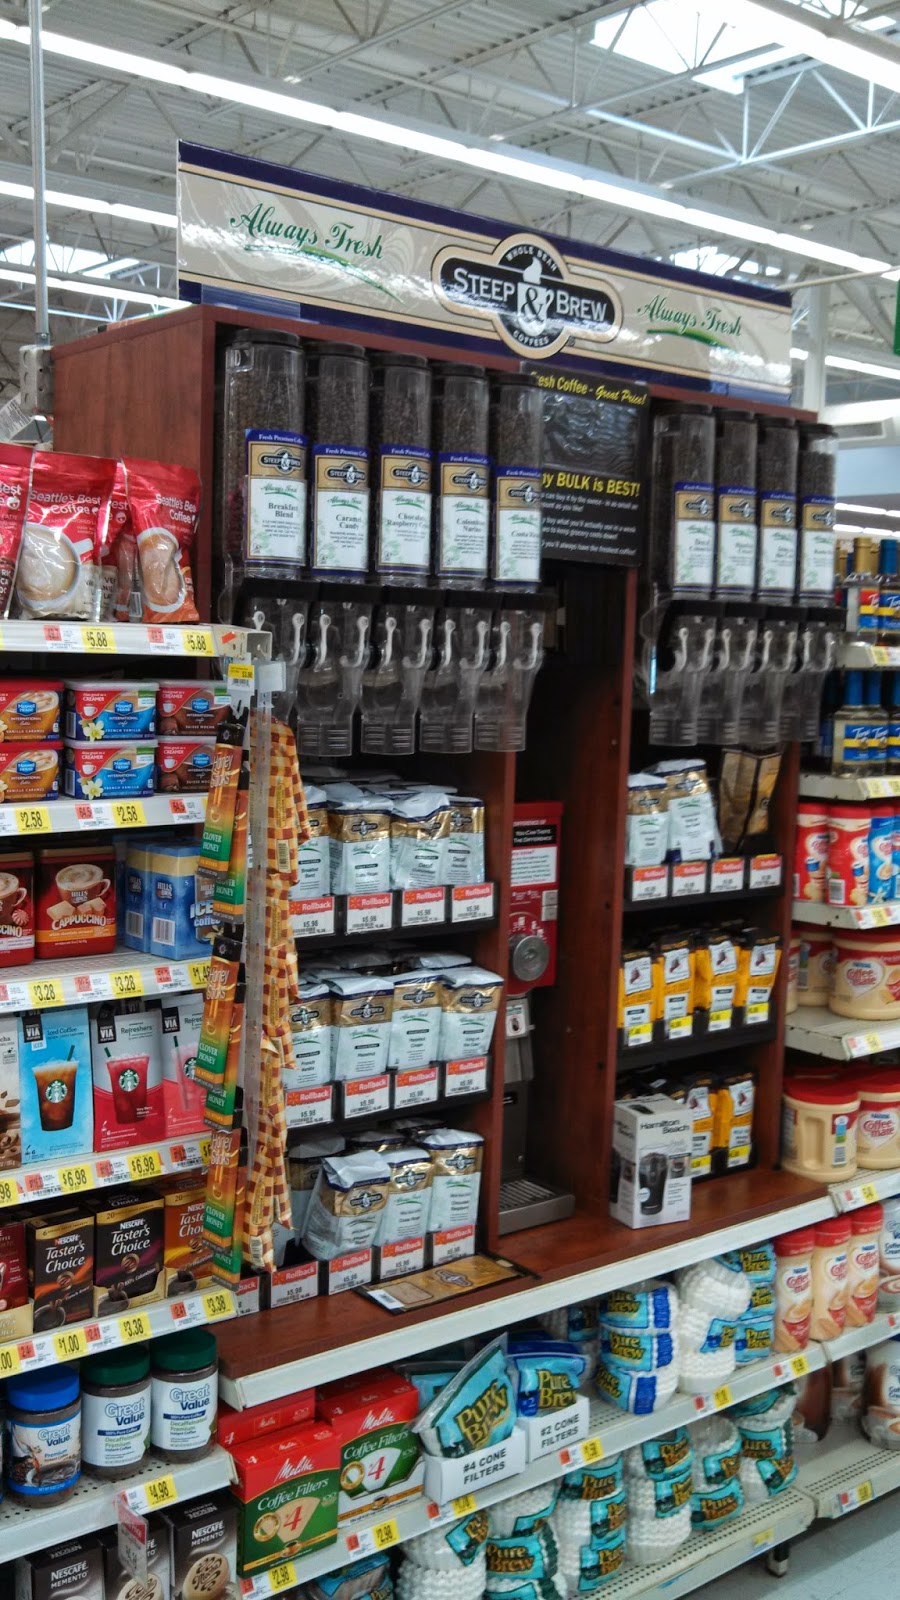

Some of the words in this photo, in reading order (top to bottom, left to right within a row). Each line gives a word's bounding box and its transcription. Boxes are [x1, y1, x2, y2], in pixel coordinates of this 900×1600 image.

[229, 203, 318, 247] Always
[324, 222, 384, 260] Fresh
[506, 245, 535, 262] WHOLE
[535, 247, 558, 272] BEAN
[453, 268, 516, 303] STEEP
[520, 287, 544, 316] &
[556, 293, 607, 322] BREW
[637, 295, 697, 334] Always
[700, 306, 742, 337] Fresh
[513, 330, 551, 348] COFFEES
[557, 377, 588, 395] Coffee
[596, 385, 620, 401] Great
[557, 472, 591, 491] BULK
[593, 478, 603, 493] is
[606, 480, 640, 498] BEST!
[29, 490, 76, 504] Seattle's
[77, 494, 102, 505] Best
[155, 494, 184, 510] Seattle's
[50, 503, 91, 514] Coffee
[169, 509, 192, 523] Coffee
[275, 510, 294, 519] Blend
[86, 632, 108, 648] $5.88
[187, 634, 207, 651] $5.88
[212, 754, 233, 774] Honey
[210, 771, 231, 788] Sticks
[20, 810, 43, 828] $2.58
[117, 806, 138, 822] $2.58
[203, 831, 222, 843] CLOVER
[203, 841, 219, 853] HONEY
[157, 881, 172, 890] HILLS
[216, 886, 234, 897] HONEY
[52, 914, 107, 930] CAPPUCCINO
[114, 974, 136, 991] $3.28
[209, 969, 230, 987] Honey
[34, 983, 56, 1001] $3.28
[120, 1025, 153, 1036] Refreshers
[164, 1019, 178, 1028] VIA
[26, 1028, 40, 1037] VIA
[100, 1029, 114, 1038] VIA
[199, 1042, 218, 1056] CLOVER
[198, 1053, 216, 1065] HONEY
[208, 1094, 225, 1107] HONEY
[640, 1119, 680, 1131] Hamilton
[662, 1125, 690, 1135] Beach
[863, 1119, 893, 1133] Coffee
[211, 1135, 232, 1152] Honey
[131, 1155, 155, 1173] $6.98
[62, 1169, 87, 1188] $6.98
[206, 1206, 225, 1220] CLOVER
[206, 1217, 224, 1230] HONEY
[111, 1224, 150, 1244] Taster's
[45, 1241, 85, 1260] Taster's
[111, 1239, 151, 1256] Choice
[45, 1256, 85, 1273] Choice
[207, 1294, 226, 1311] $3.38
[124, 1319, 144, 1337] $3.38
[59, 1336, 80, 1353] $1.00
[538, 1369, 572, 1389] Pure
[170, 1384, 210, 1402] Great
[538, 1387, 577, 1408] Brew
[105, 1397, 145, 1418] Great
[180, 1397, 210, 1411] Value
[115, 1411, 145, 1426] Value
[360, 1407, 395, 1432] Melitta
[540, 1424, 552, 1436] #2
[554, 1413, 580, 1431] CONE
[38, 1424, 71, 1441] Great
[47, 1435, 71, 1447] Value
[541, 1427, 579, 1449] FILTERS
[344, 1438, 377, 1460] Coffee
[378, 1429, 409, 1448] Filters
[463, 1459, 476, 1473] #4
[478, 1448, 507, 1468] CONE
[274, 1456, 314, 1483] Melitta
[464, 1463, 506, 1485] FILTERS
[150, 1483, 169, 1500] $4.98
[257, 1488, 294, 1511] Coffee
[295, 1477, 329, 1497] Filters
[191, 1520, 224, 1539] NESCAFÉ
[191, 1531, 224, 1547] MEMENTO
[50, 1561, 88, 1582] NESCAFÉ
[50, 1572, 88, 1589] MEMENTO
